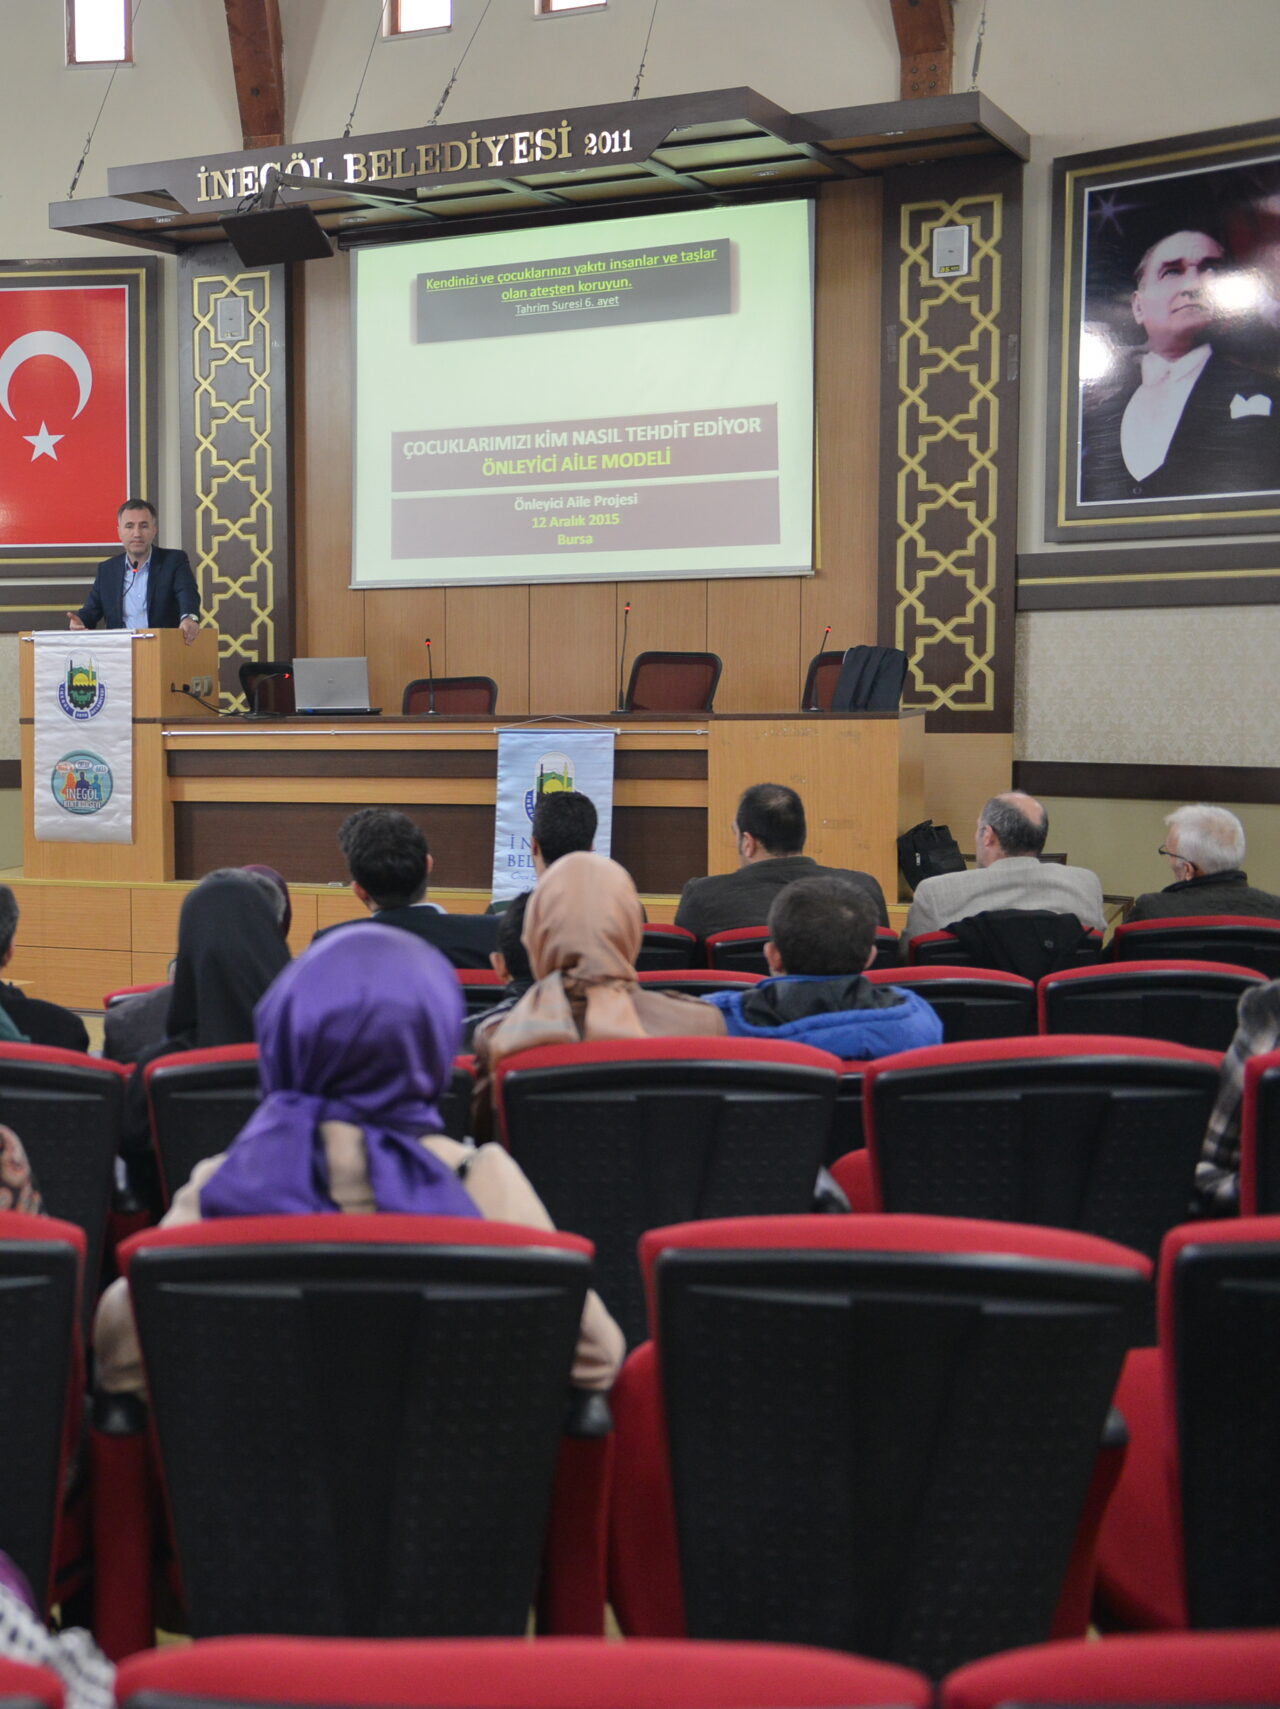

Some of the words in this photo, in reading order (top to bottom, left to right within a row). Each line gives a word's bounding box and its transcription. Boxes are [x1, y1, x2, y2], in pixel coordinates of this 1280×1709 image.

[344, 119, 574, 184] BELEDİYESİ
[583, 129, 633, 156] 2011
[426, 273, 478, 290] Kendinizi
[480, 274, 494, 284] ve
[497, 266, 571, 284] çocuklarınızı
[574, 261, 606, 276] yakıtı
[610, 254, 660, 270] insanlar
[663, 253, 678, 263] ve
[681, 248, 717, 262] taşlar
[501, 288, 527, 300] olan
[530, 283, 575, 297] ateşten
[578, 277, 632, 292] koruyun.
[515, 302, 550, 315] Tahrim
[551, 298, 583, 311] Suresi
[584, 297, 594, 307] 6.
[597, 296, 619, 307] ayet
[403, 434, 531, 460] ÇOCUKLARIMIZI
[535, 429, 568, 449] KİM
[572, 428, 623, 446] NASIL
[625, 420, 690, 442] TEHDİT
[693, 416, 762, 437] EDİYOR
[482, 454, 557, 476] ÖNLEYİCİ
[561, 452, 597, 472] AİLE
[601, 446, 671, 469] MODELİ
[514, 496, 564, 512] Önleyici
[566, 496, 591, 508] Aile
[594, 492, 638, 509] Projesi
[532, 517, 547, 528] 12
[549, 515, 586, 528] Aralık
[588, 513, 620, 526] 2015
[557, 534, 593, 545] Bursa
